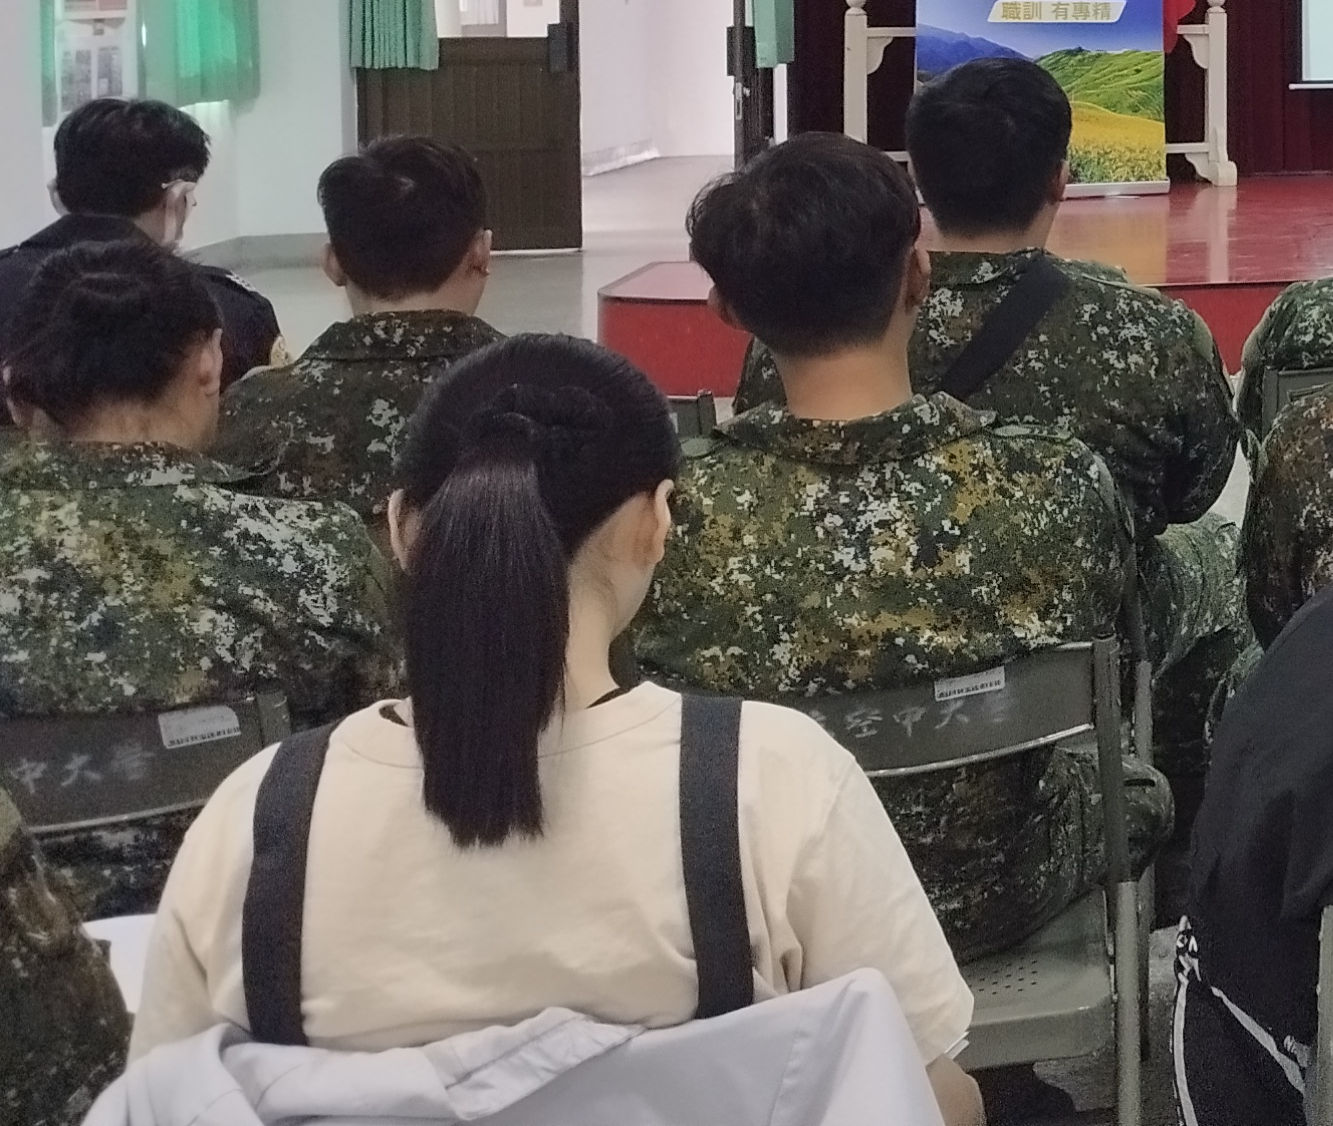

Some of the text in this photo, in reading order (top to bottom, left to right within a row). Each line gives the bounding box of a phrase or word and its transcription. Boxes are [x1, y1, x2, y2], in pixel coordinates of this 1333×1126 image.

[1001, 1, 1111, 20] 職訓 有專精
